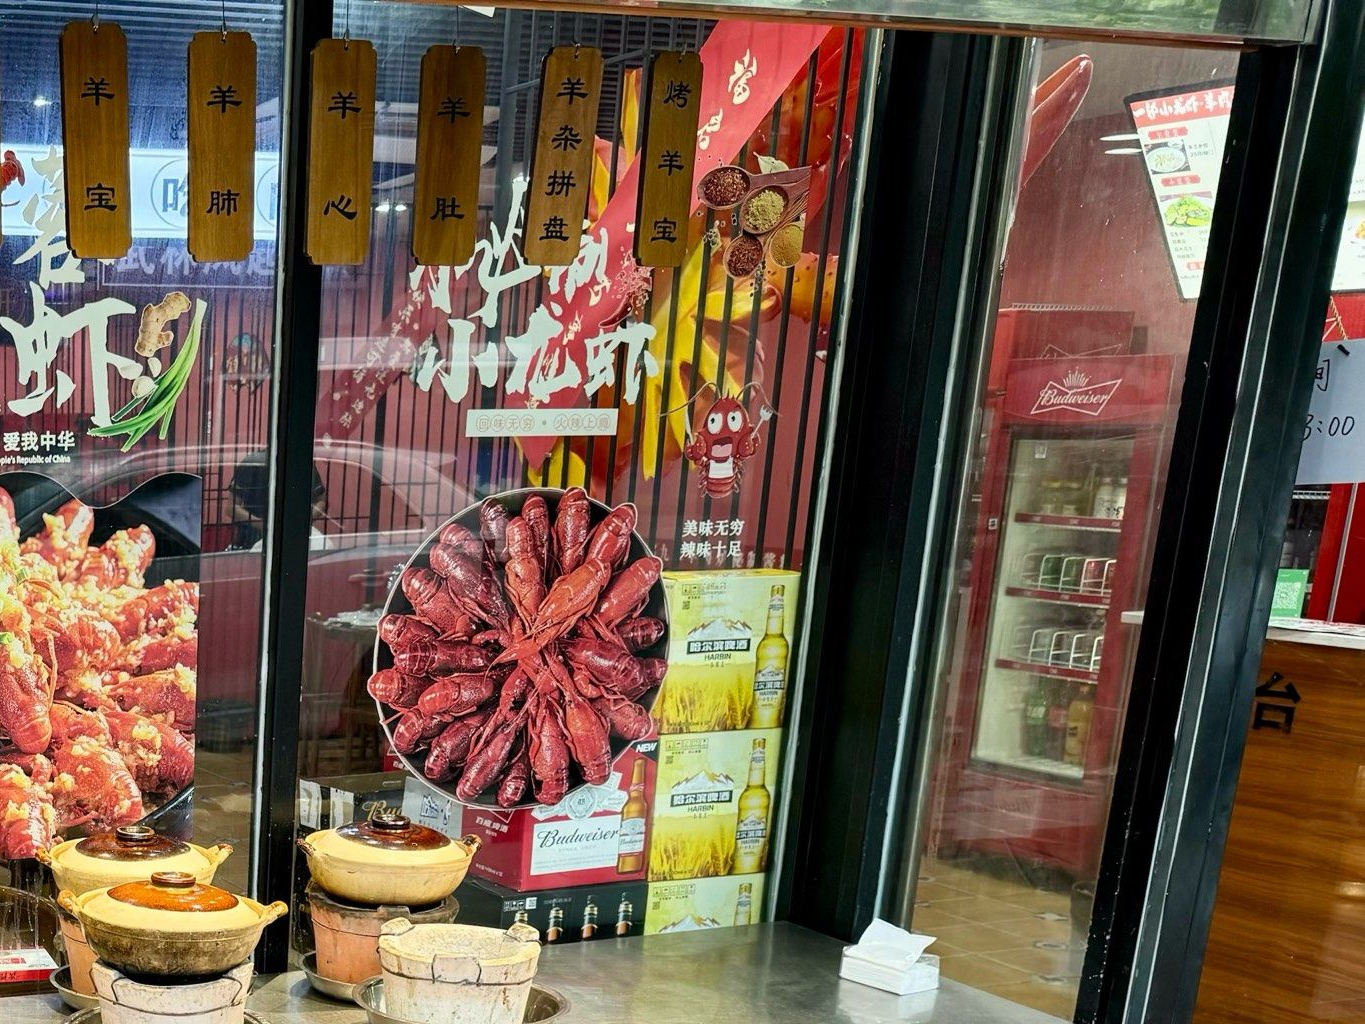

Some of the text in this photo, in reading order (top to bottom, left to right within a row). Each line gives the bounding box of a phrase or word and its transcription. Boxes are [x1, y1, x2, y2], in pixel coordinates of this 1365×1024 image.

[81, 76, 118, 213] 羊宝
[206, 83, 242, 217] 羊肺
[324, 90, 362, 222] 羊心
[430, 96, 471, 222] 羊肚
[540, 76, 589, 242] 羊杂拼盘
[650, 78, 692, 244] 烤羊宝
[417, 304, 660, 404] 小龙虾
[1039, 386, 1108, 405] Budweiser
[3, 430, 76, 452] 爱我中华
[17, 455, 43, 465] Republic
[53, 455, 70, 464] China
[680, 540, 742, 558] 辣味十足
[682, 519, 745, 537] 美味无穷
[704, 653, 732, 661] HARBIN
[1253, 671, 1301, 734] 台
[636, 742, 657, 752] NEW
[537, 827, 620, 848] Budweiser
